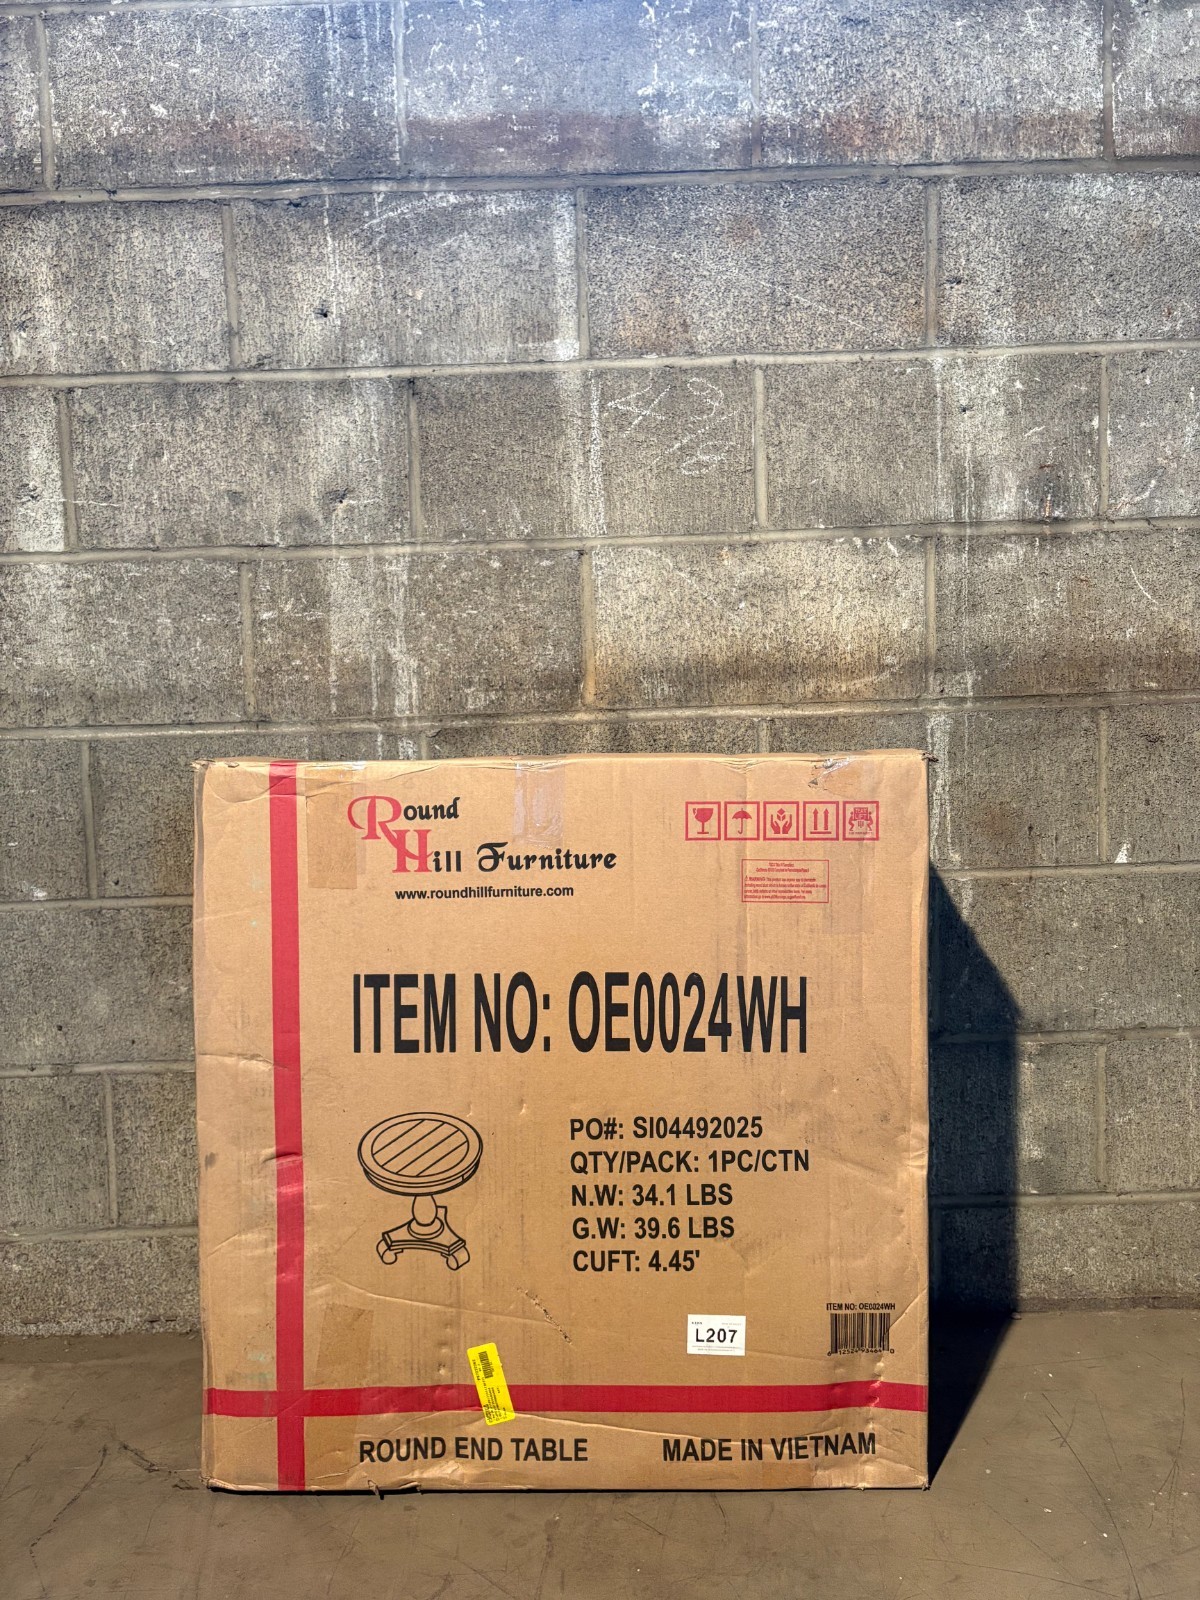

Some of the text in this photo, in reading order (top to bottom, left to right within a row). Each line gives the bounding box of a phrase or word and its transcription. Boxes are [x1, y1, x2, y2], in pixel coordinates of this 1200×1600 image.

[347, 795, 460, 841] Round
[392, 829, 617, 873] Hill Furniture
[394, 886, 574, 900] www.roundhillfurniture.com
[353, 970, 807, 1054] ITEM NO: OE0024WH
[570, 1115, 763, 1141] PO#: SI04492025
[570, 1149, 809, 1175] QTY/PACK: 1PC/CTN
[571, 1182, 733, 1207] N.W: 34.1 LBS
[572, 1215, 735, 1240] G.W: 39.6 LBS
[572, 1249, 700, 1272] CUFT: 4.45'
[826, 1302, 896, 1311] ITEM NO: OE0024WH
[695, 1328, 738, 1344] L207
[359, 1436, 588, 1463] ROUND END TABLE
[662, 1431, 876, 1462] MADE IN VIETNAM
